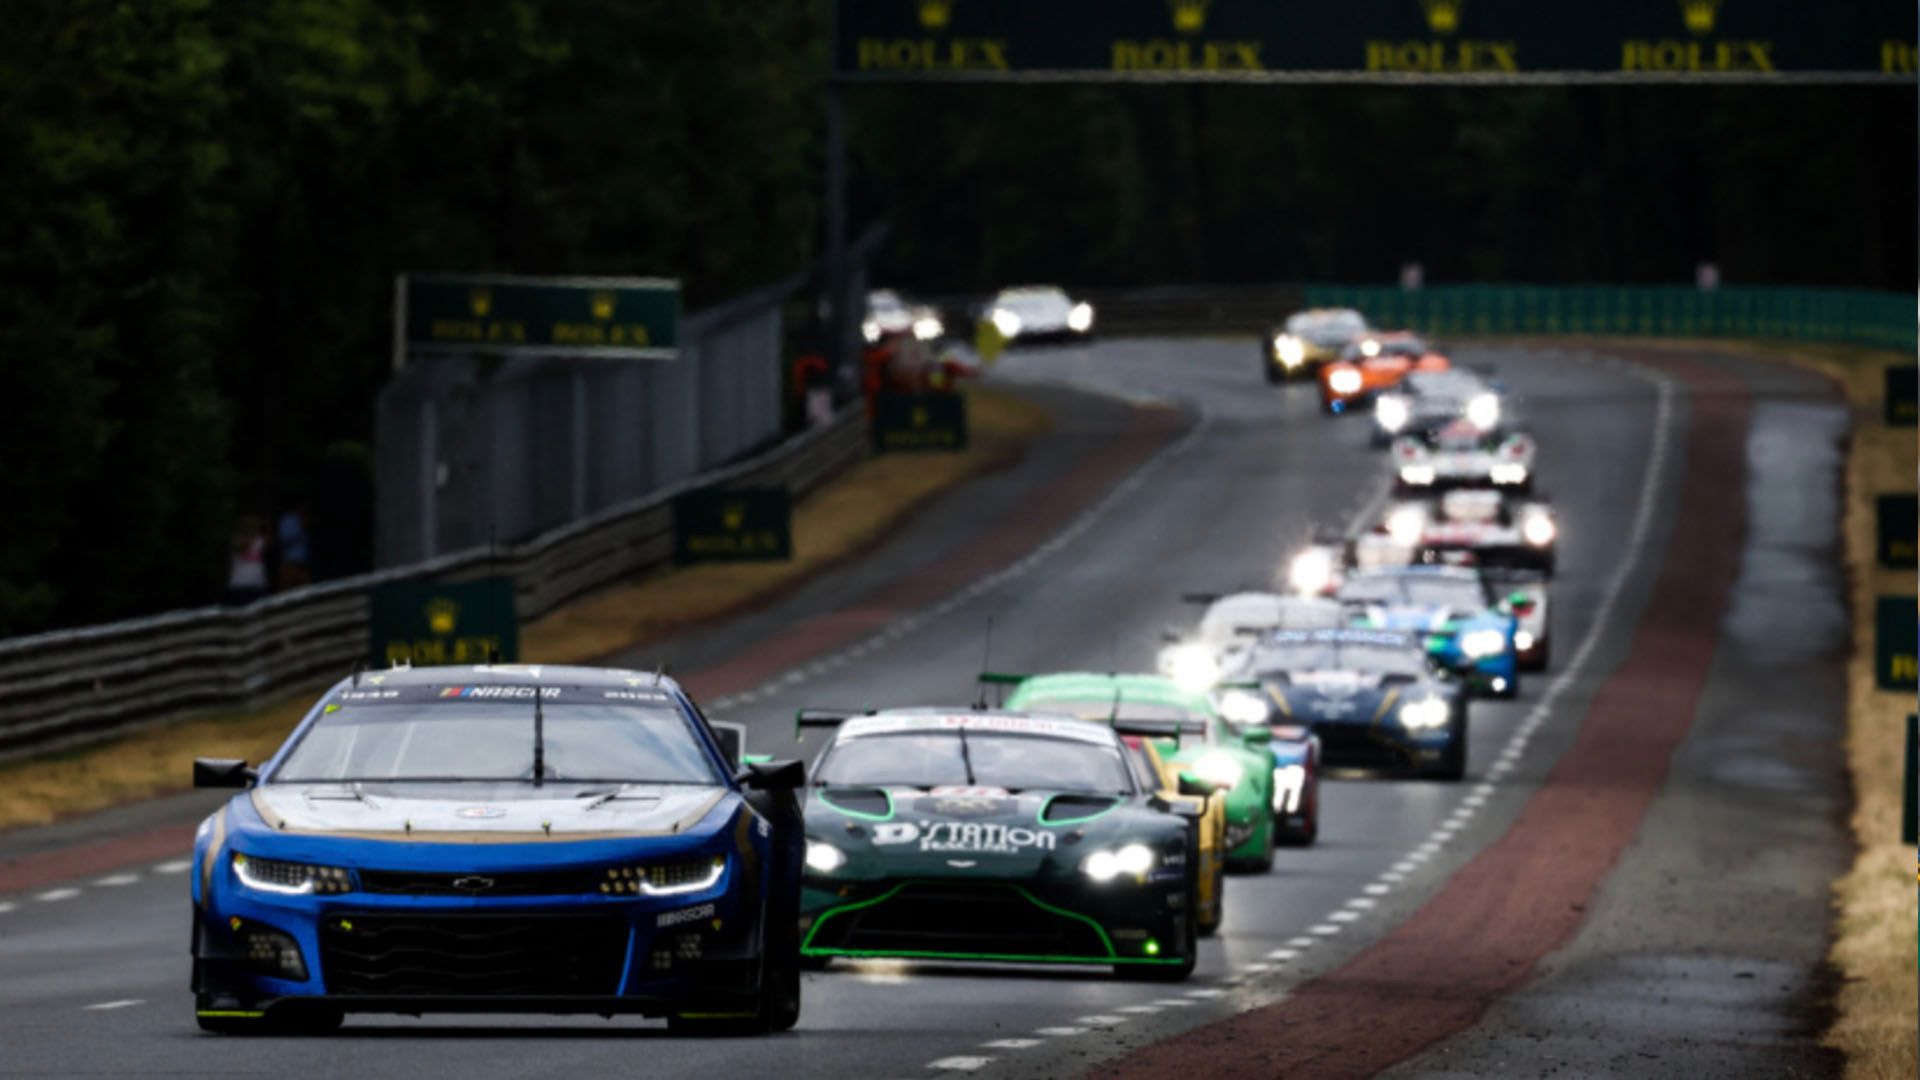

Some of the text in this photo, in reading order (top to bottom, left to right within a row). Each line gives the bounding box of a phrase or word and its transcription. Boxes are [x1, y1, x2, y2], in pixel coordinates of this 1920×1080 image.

[858, 39, 1009, 70] ROLEX
[1112, 40, 1264, 72] ROLEX
[1366, 40, 1516, 72] ROLEX
[1622, 40, 1775, 72] ROLEX
[470, 686, 561, 698] NASCAR
